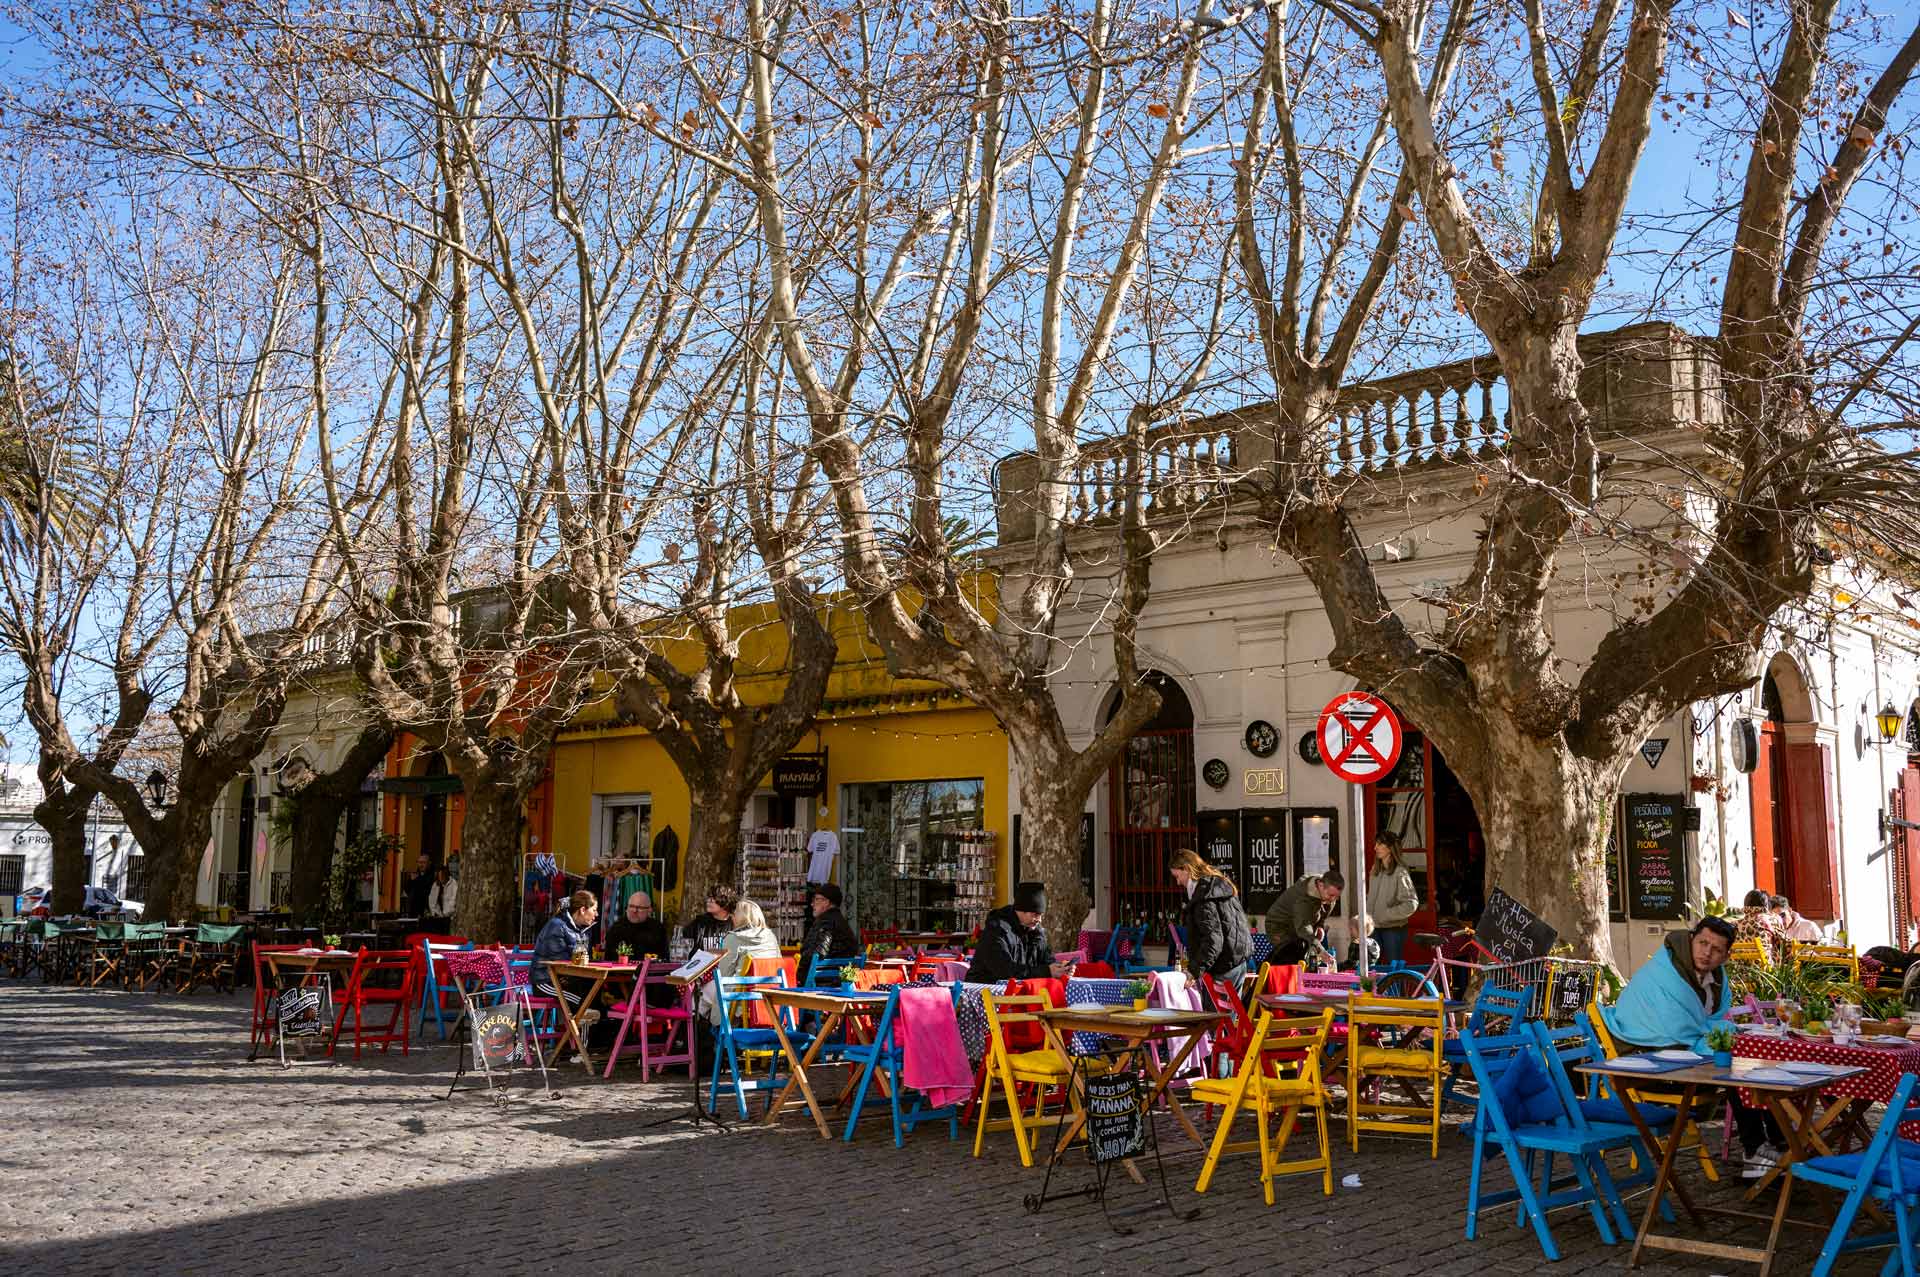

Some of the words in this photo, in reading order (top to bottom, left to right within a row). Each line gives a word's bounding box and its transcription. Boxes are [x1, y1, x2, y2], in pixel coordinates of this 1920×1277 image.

[1246, 772, 1281, 791] OPEN
[1251, 833, 1280, 861] ¡QUÉ
[1637, 840, 1658, 849] PICADA
[1250, 859, 1280, 885] TUPÉ
[1640, 869, 1672, 877] CASERAS
[1641, 862, 1667, 870] RABAS
[1510, 903, 1533, 930] Hoy
[479, 1015, 497, 1037] POKE
[1098, 1085, 1116, 1096] DEJES
[1091, 1095, 1135, 1113] MAÑANA
[1101, 1124, 1129, 1136] COMERTE
[1103, 1136, 1127, 1159] HOY
